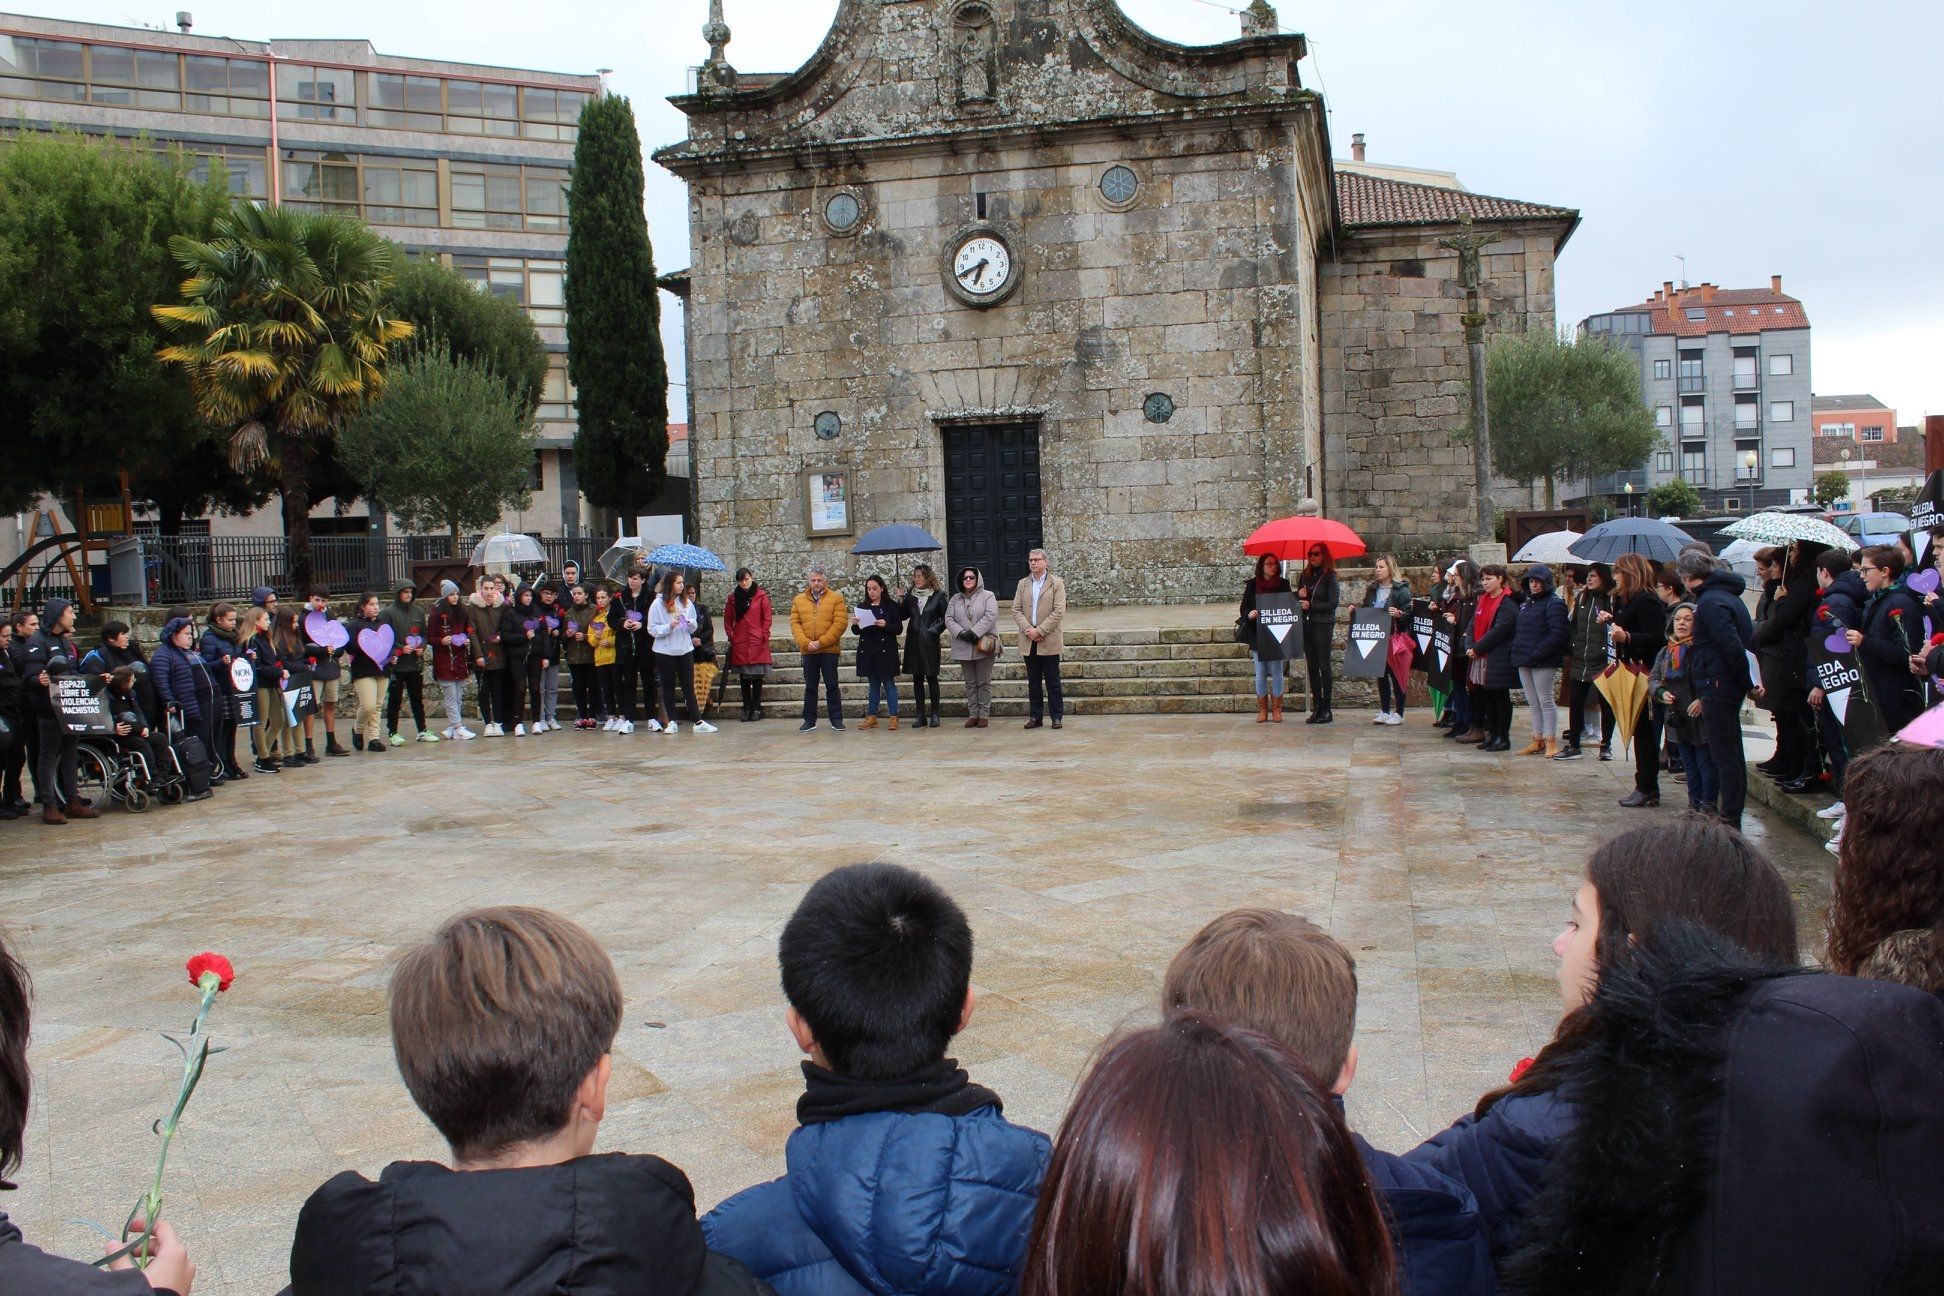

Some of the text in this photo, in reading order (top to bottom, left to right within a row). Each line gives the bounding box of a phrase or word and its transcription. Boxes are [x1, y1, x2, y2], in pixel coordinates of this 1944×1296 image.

[1260, 608, 1292, 617] SILLEDA
[1261, 615, 1298, 624] EN NEGRO
[234, 668, 250, 678] NON
[1817, 660, 1844, 678] EDA
[59, 680, 86, 688] ESPAZO
[82, 689, 90, 697] DE
[60, 698, 100, 706] VIOLENCIAS
